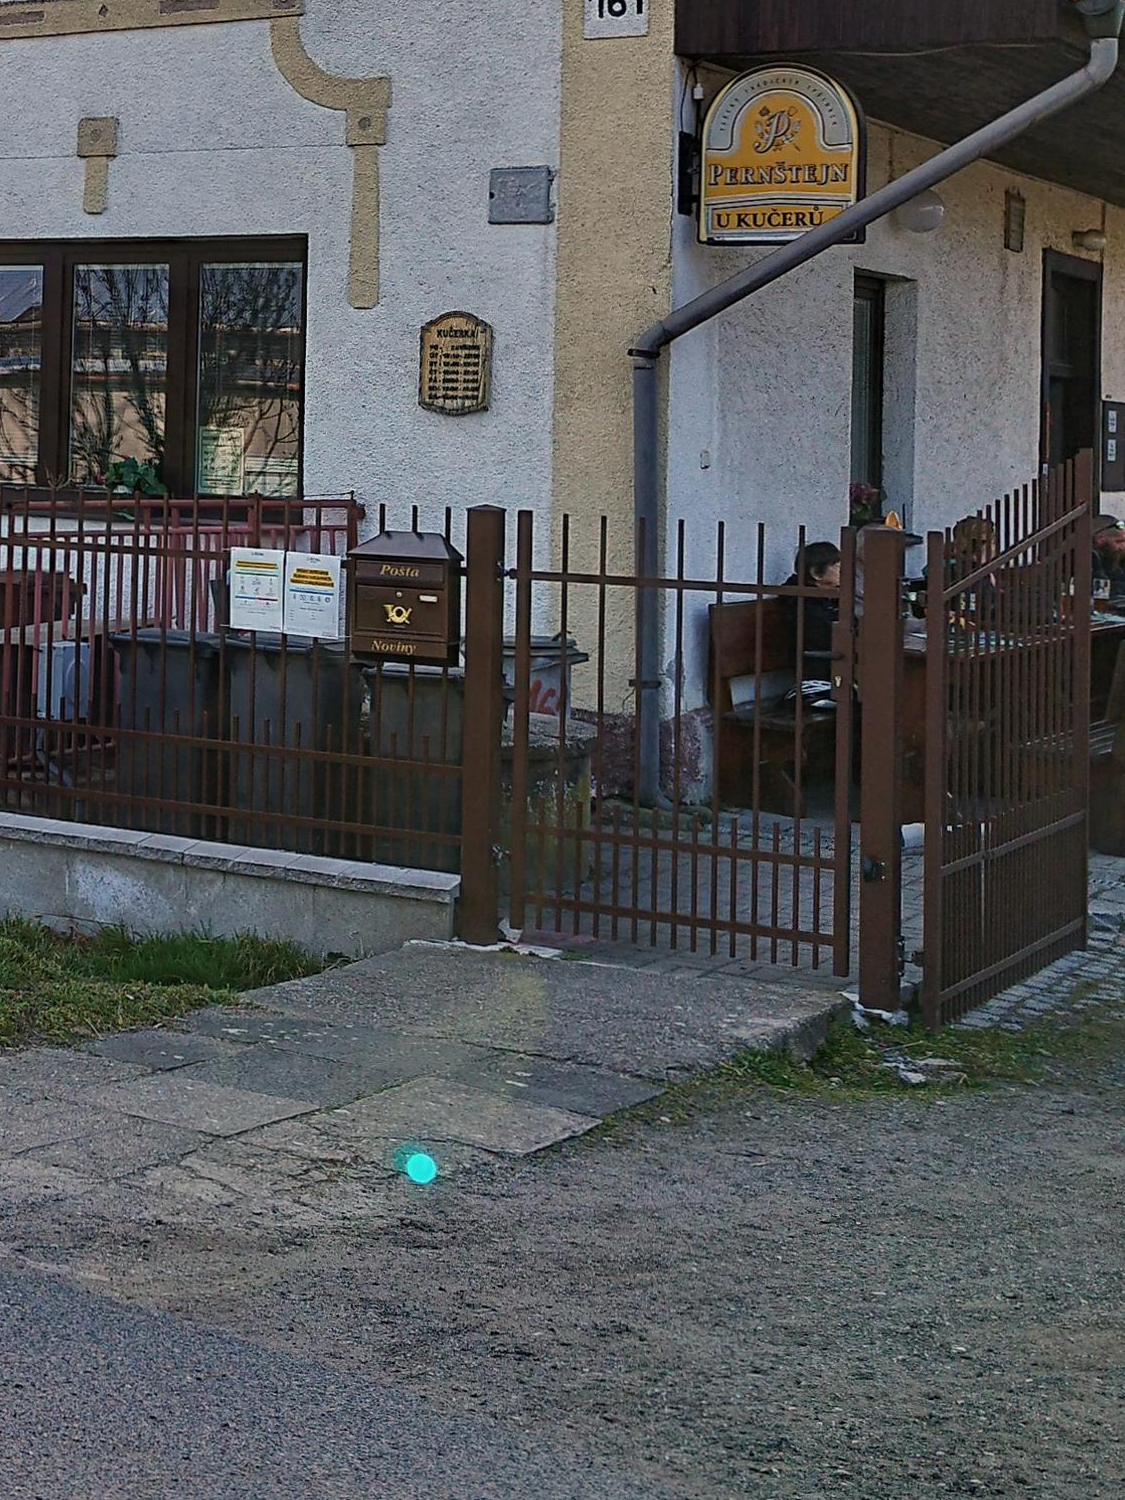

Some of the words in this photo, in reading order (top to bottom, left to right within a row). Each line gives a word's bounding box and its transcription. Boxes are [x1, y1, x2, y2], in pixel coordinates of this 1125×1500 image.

[707, 161, 849, 186] PERNŠTEJN
[715, 212, 731, 229] U
[736, 205, 826, 229] KUČERŮ
[379, 564, 420, 578] Pošta
[371, 640, 417, 656] Noviny
